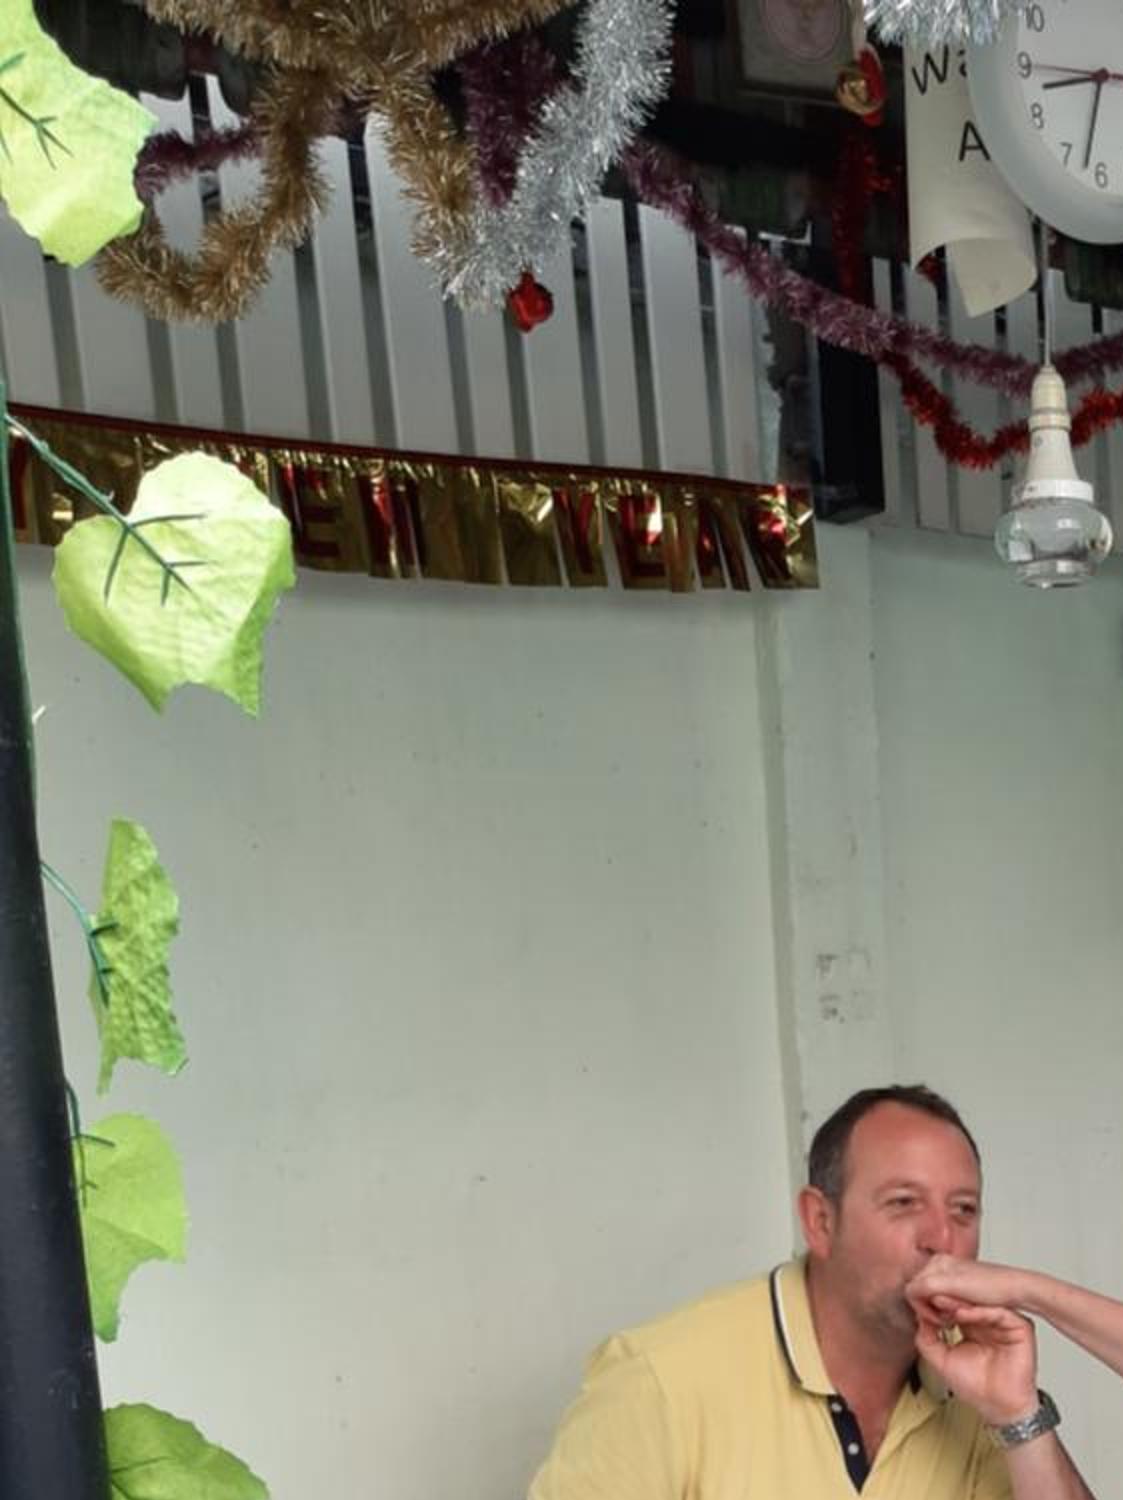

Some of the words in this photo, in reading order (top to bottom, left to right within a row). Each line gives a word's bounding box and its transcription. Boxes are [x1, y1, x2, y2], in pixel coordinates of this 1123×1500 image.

[1025, 4, 1045, 33] 10
[1018, 51, 1033, 79] 9
[1031, 103, 1045, 131] 8
[1060, 142, 1073, 167] 7
[1094, 162, 1109, 189] 6
